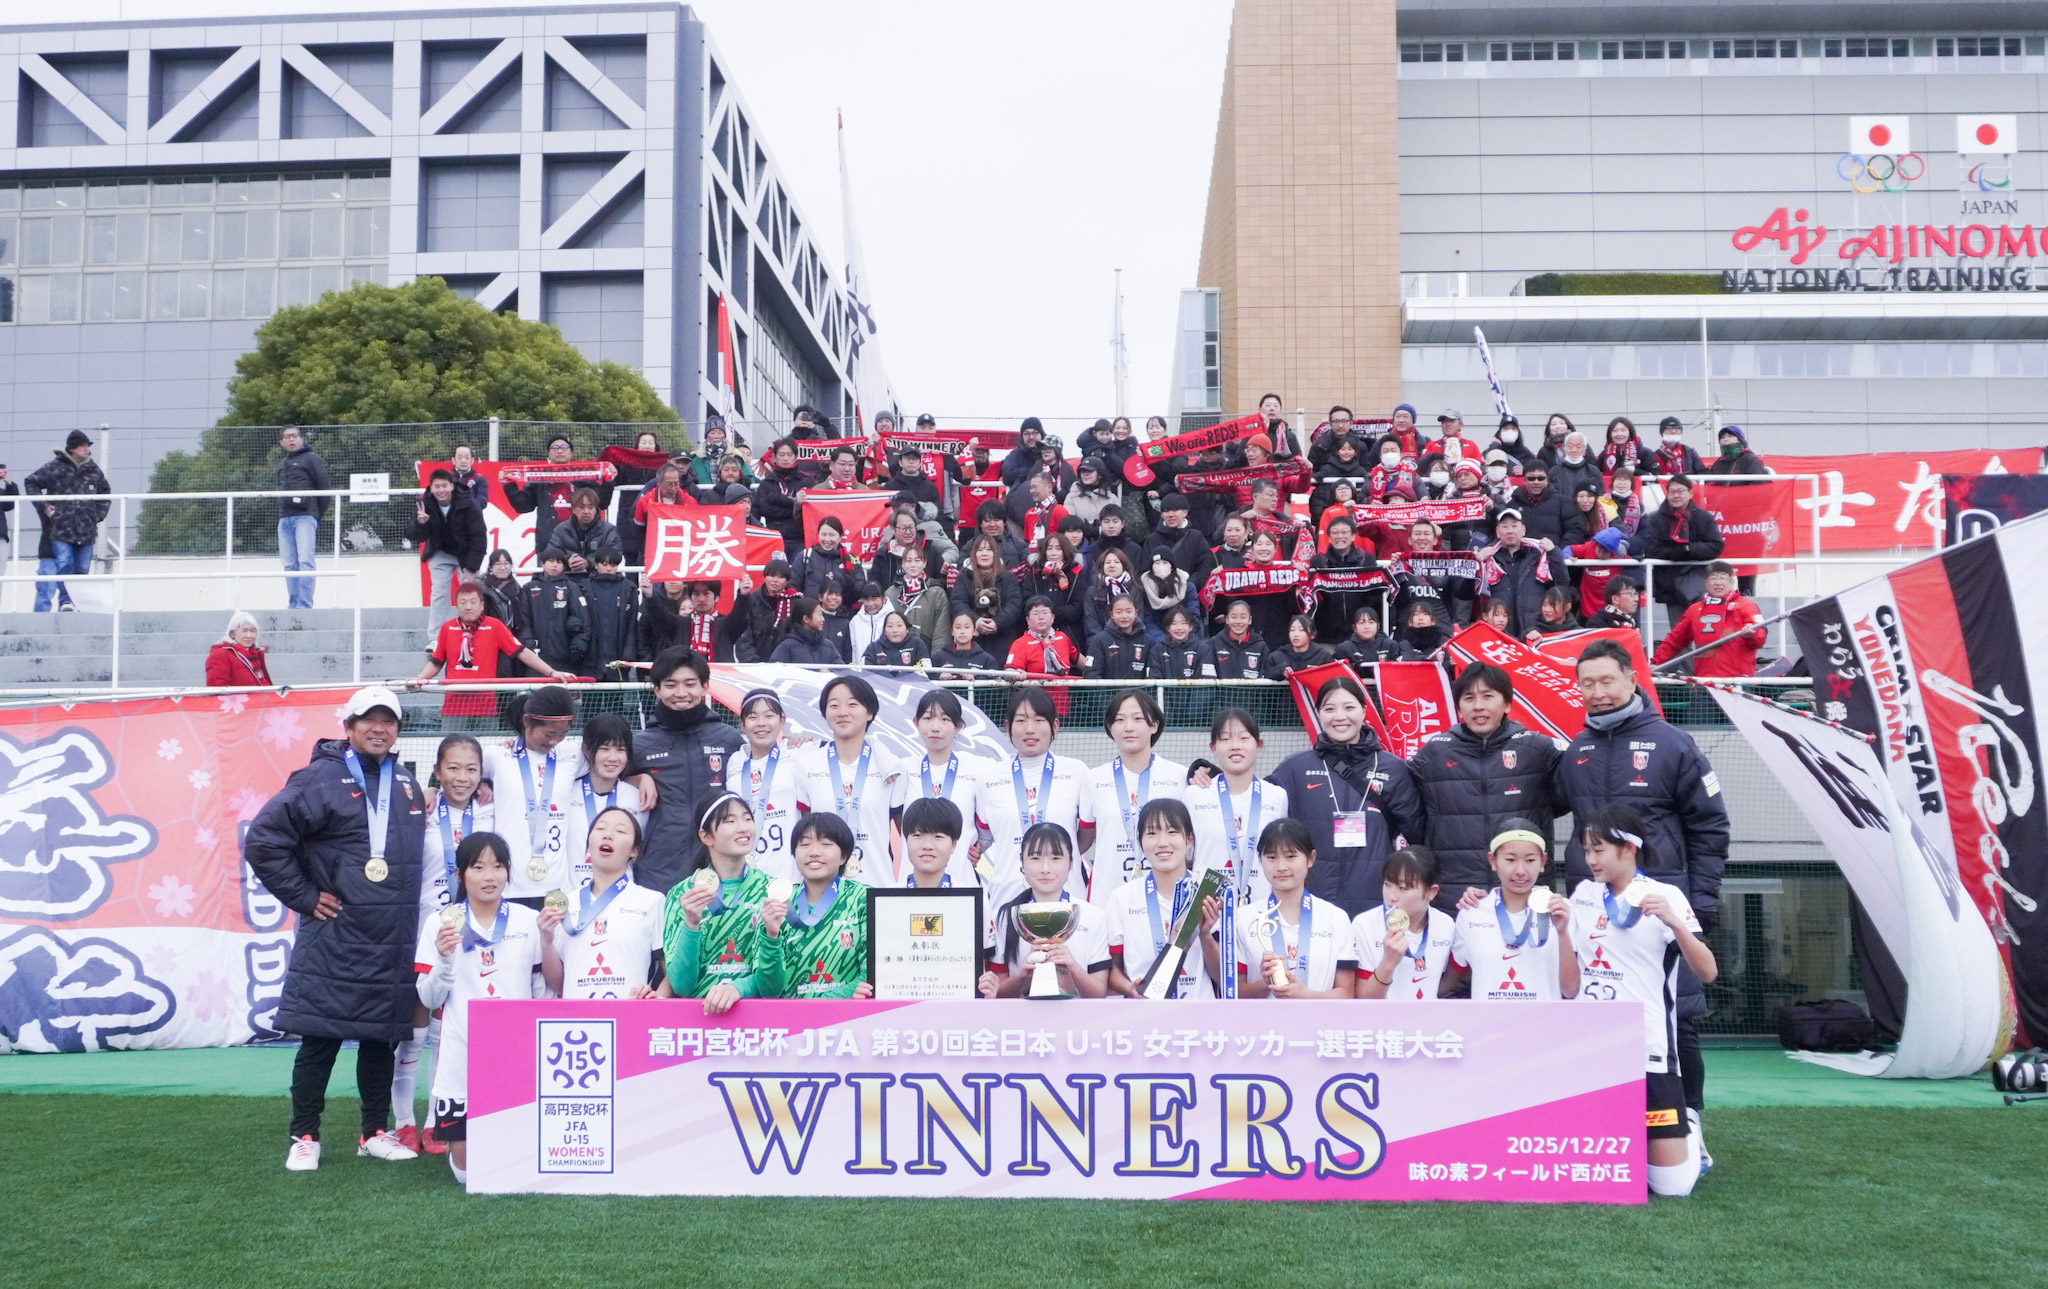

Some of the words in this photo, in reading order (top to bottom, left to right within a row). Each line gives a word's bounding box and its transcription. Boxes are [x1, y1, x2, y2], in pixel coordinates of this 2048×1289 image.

[1961, 200, 2018, 214] JAPAN
[1839, 223, 2048, 264] AJINOM
[1722, 268, 1871, 289] NATIONAL
[1888, 267, 2028, 289] TRAINING
[1166, 440, 1186, 454] We
[1187, 437, 1206, 450] are
[1206, 423, 1239, 446] REDS!
[909, 440, 966, 455] WINNERS
[1716, 520, 1777, 535] IAMONDS
[1225, 570, 1267, 591] URAWA
[1269, 568, 1300, 585] REDS
[1430, 568, 1446, 577] are
[1409, 586, 1444, 599] POLU
[1533, 662, 1583, 691] URAW
[1853, 613, 1906, 764] YONEDANA
[1876, 605, 1912, 696] CRIM
[1905, 724, 1944, 816] STAR
[771, 747, 779, 759] JFA
[863, 745, 871, 757] JFA
[949, 759, 957, 772] JFA
[1218, 780, 1227, 793] JFA
[379, 798, 387, 812] JFA
[541, 798, 549, 812] JFA
[758, 798, 766, 811] JFA
[1021, 811, 1029, 825] JFA
[1122, 808, 1131, 822] JFA
[1229, 837, 1237, 851] JFA
[615, 879, 628, 890] JFA
[705, 873, 717, 886] JFA
[1205, 872, 1220, 886] JFA
[501, 902, 509, 915] JFA
[1303, 896, 1311, 910] JFA
[619, 907, 648, 917] EneCle
[1468, 921, 1496, 929] EneCle
[911, 941, 940, 950] 表彰状
[1299, 955, 1307, 971] JFA
[577, 976, 625, 984] MITSUBISHI
[648, 1027, 789, 1057] 高円宮妃杯
[796, 1028, 860, 1057] JFA
[872, 1028, 1056, 1058] 第30回全日本
[1067, 1030, 1133, 1057] U-15
[1144, 1029, 1464, 1060] 女子サッカー選手権大会
[565, 1050, 588, 1070] 15
[544, 1103, 609, 1116] 高円宮妃杯
[565, 1121, 588, 1132] JFA
[707, 1072, 1388, 1180] WINNERS
[563, 1134, 589, 1145] U-15
[1507, 1136, 1631, 1155] 2025/12/27
[548, 1147, 605, 1157] WOMEN'S
[1409, 1163, 1632, 1184] 味の素フィールド西が丘
